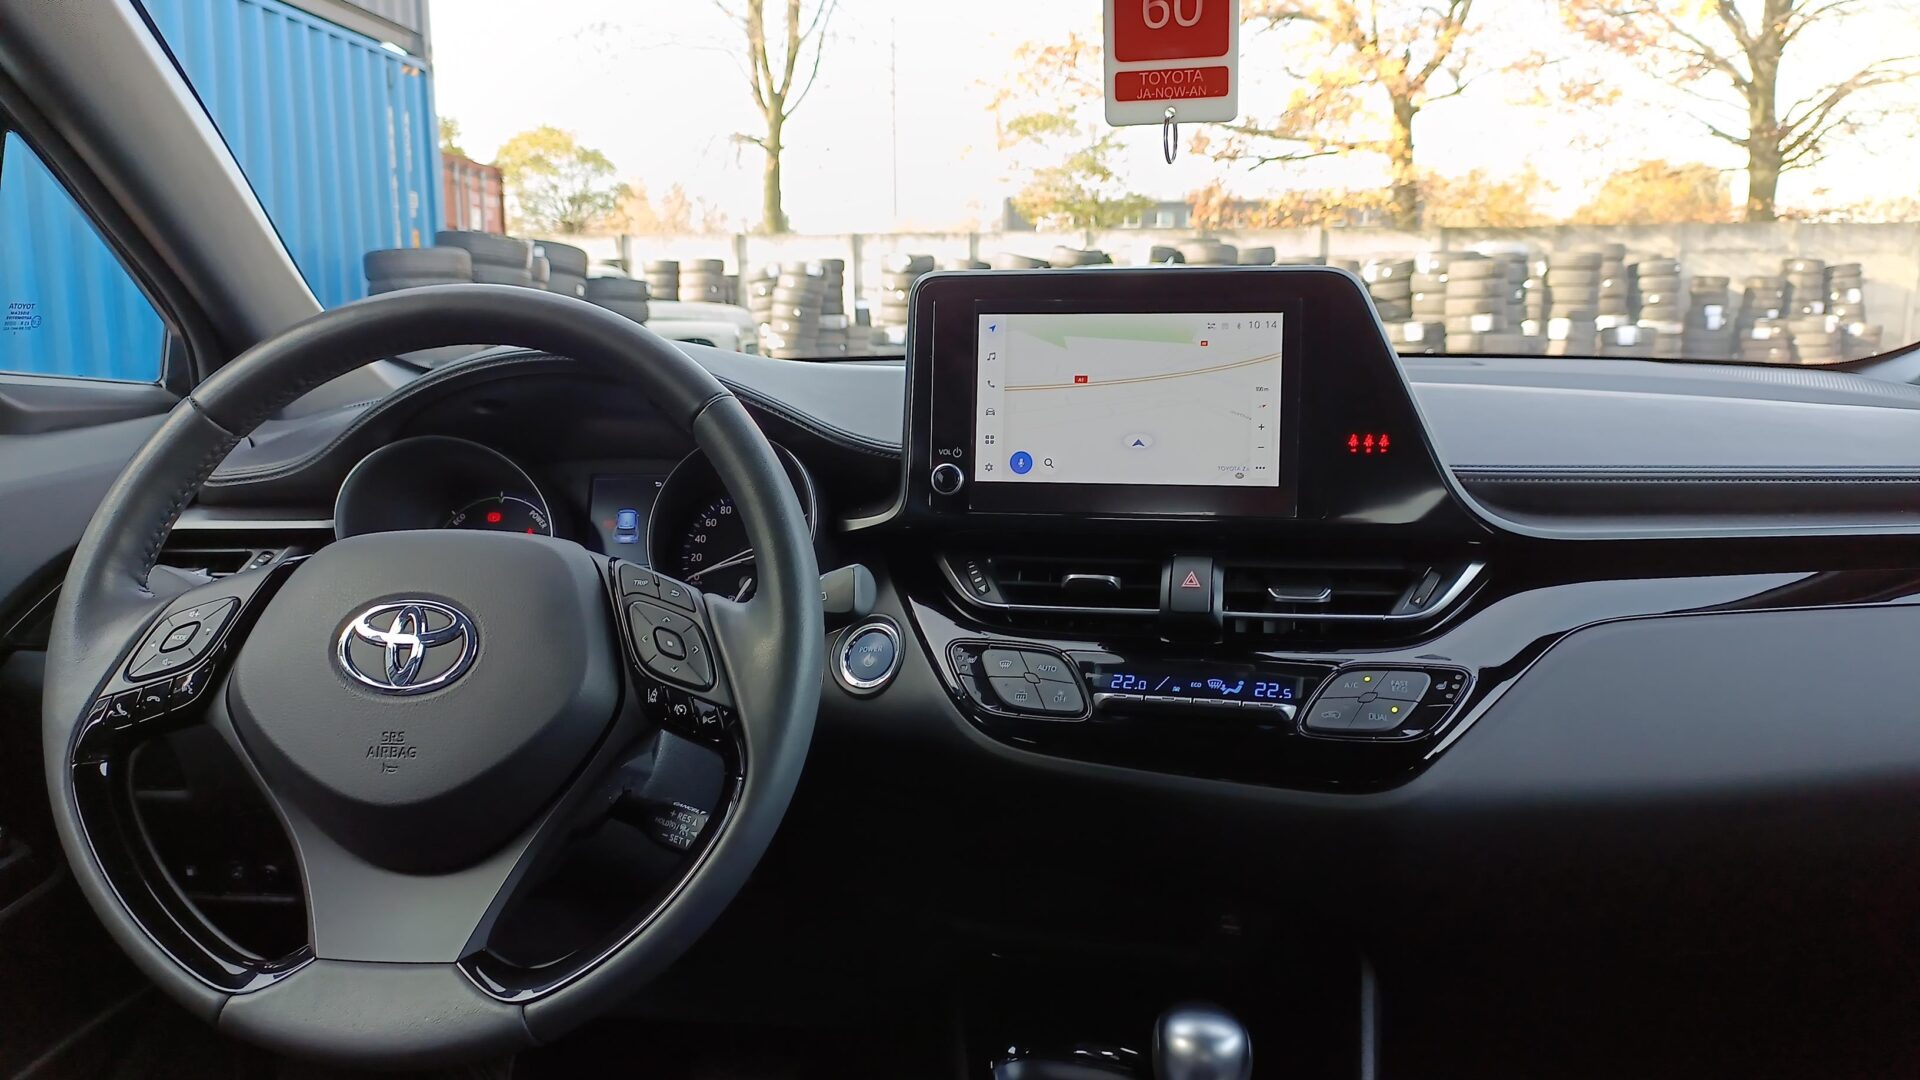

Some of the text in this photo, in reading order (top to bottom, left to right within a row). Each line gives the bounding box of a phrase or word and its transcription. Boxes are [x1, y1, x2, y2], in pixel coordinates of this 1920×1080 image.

[1143, 0, 1203, 29] 60
[1139, 70, 1203, 85] TOYOTA
[938, 448, 951, 456] VOL
[720, 506, 732, 515] 80
[452, 513, 466, 526] ECO
[528, 509, 548, 529] POWER
[705, 518, 717, 527] 60
[694, 535, 707, 544] 40
[690, 553, 703, 562] 20
[633, 579, 649, 587] TRIP
[1037, 664, 1057, 673] AUTO
[1110, 674, 1147, 691] 22.0
[1254, 682, 1292, 699] 22.5
[1344, 682, 1359, 690] A/C
[1368, 712, 1389, 722] DUAL
[381, 731, 405, 742] SRS
[366, 745, 417, 759] AIRBAG
